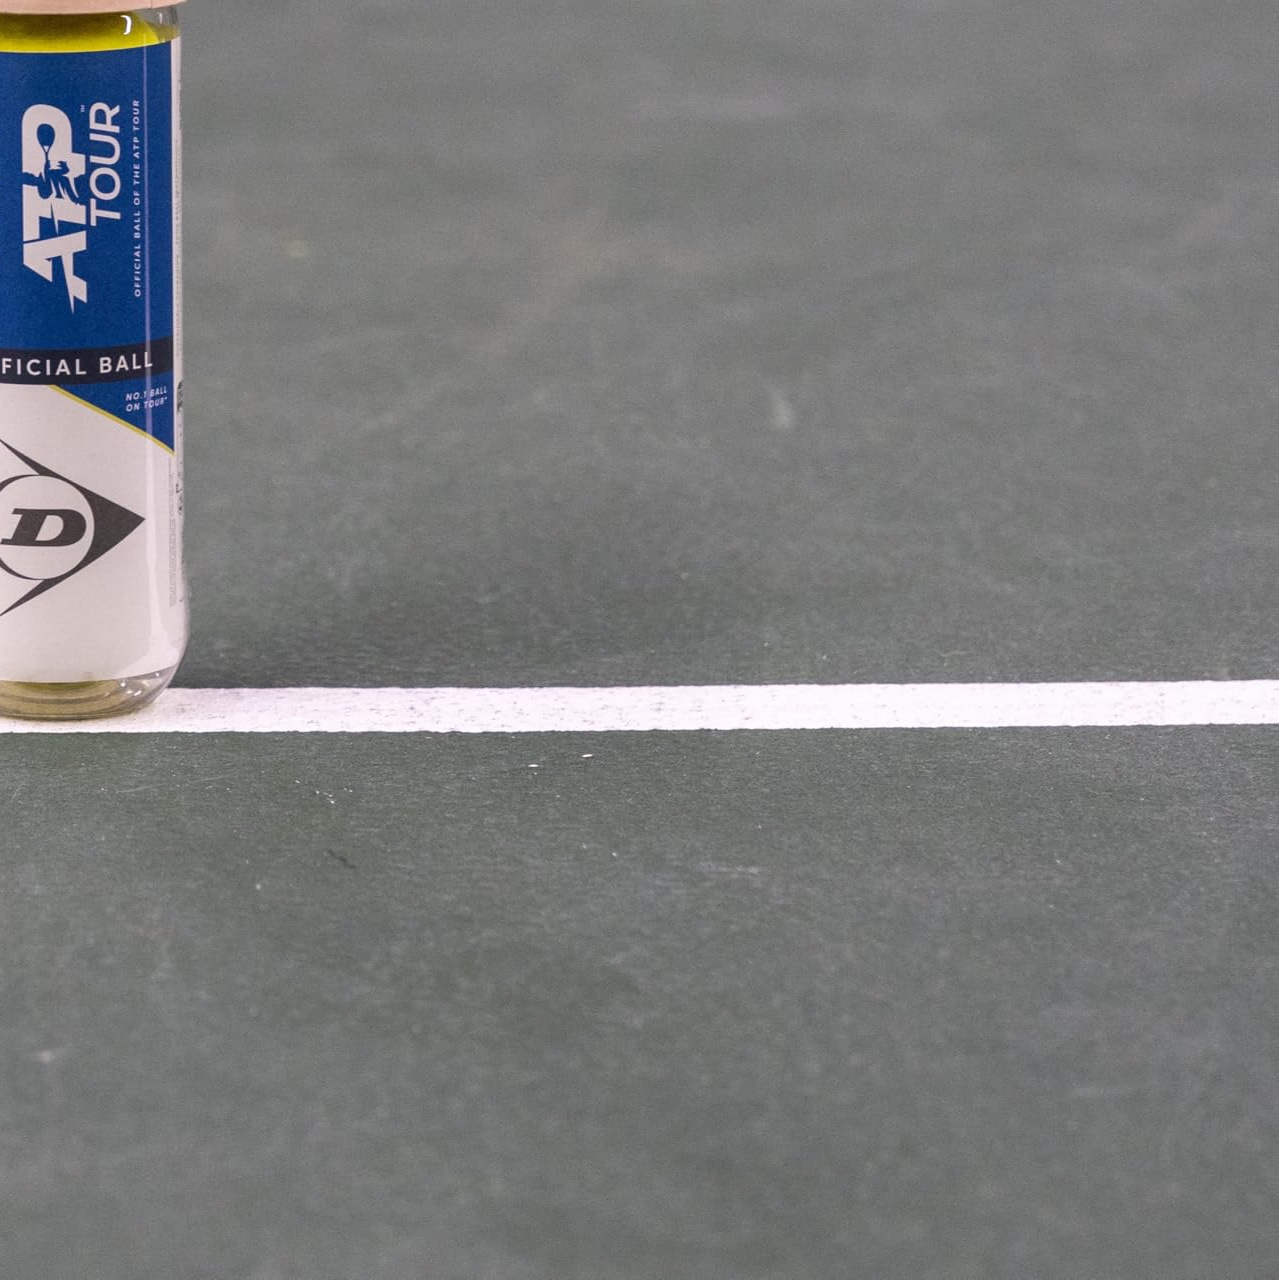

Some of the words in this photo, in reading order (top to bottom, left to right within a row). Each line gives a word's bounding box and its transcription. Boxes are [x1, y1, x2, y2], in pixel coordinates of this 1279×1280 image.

[133, 99, 142, 131] TOUR
[133, 136, 142, 158] ATP
[89, 102, 121, 226] TOUR
[133, 166, 142, 187] THE
[22, 104, 87, 314] ATP
[133, 193, 142, 206] OF
[133, 211, 142, 239] BALL
[133, 244, 142, 298] OFFICIAL
[99, 351, 153, 373] BALL
[149, 385, 168, 397] BALL
[125, 402, 140, 412] ON
[0, 508, 87, 547] D
